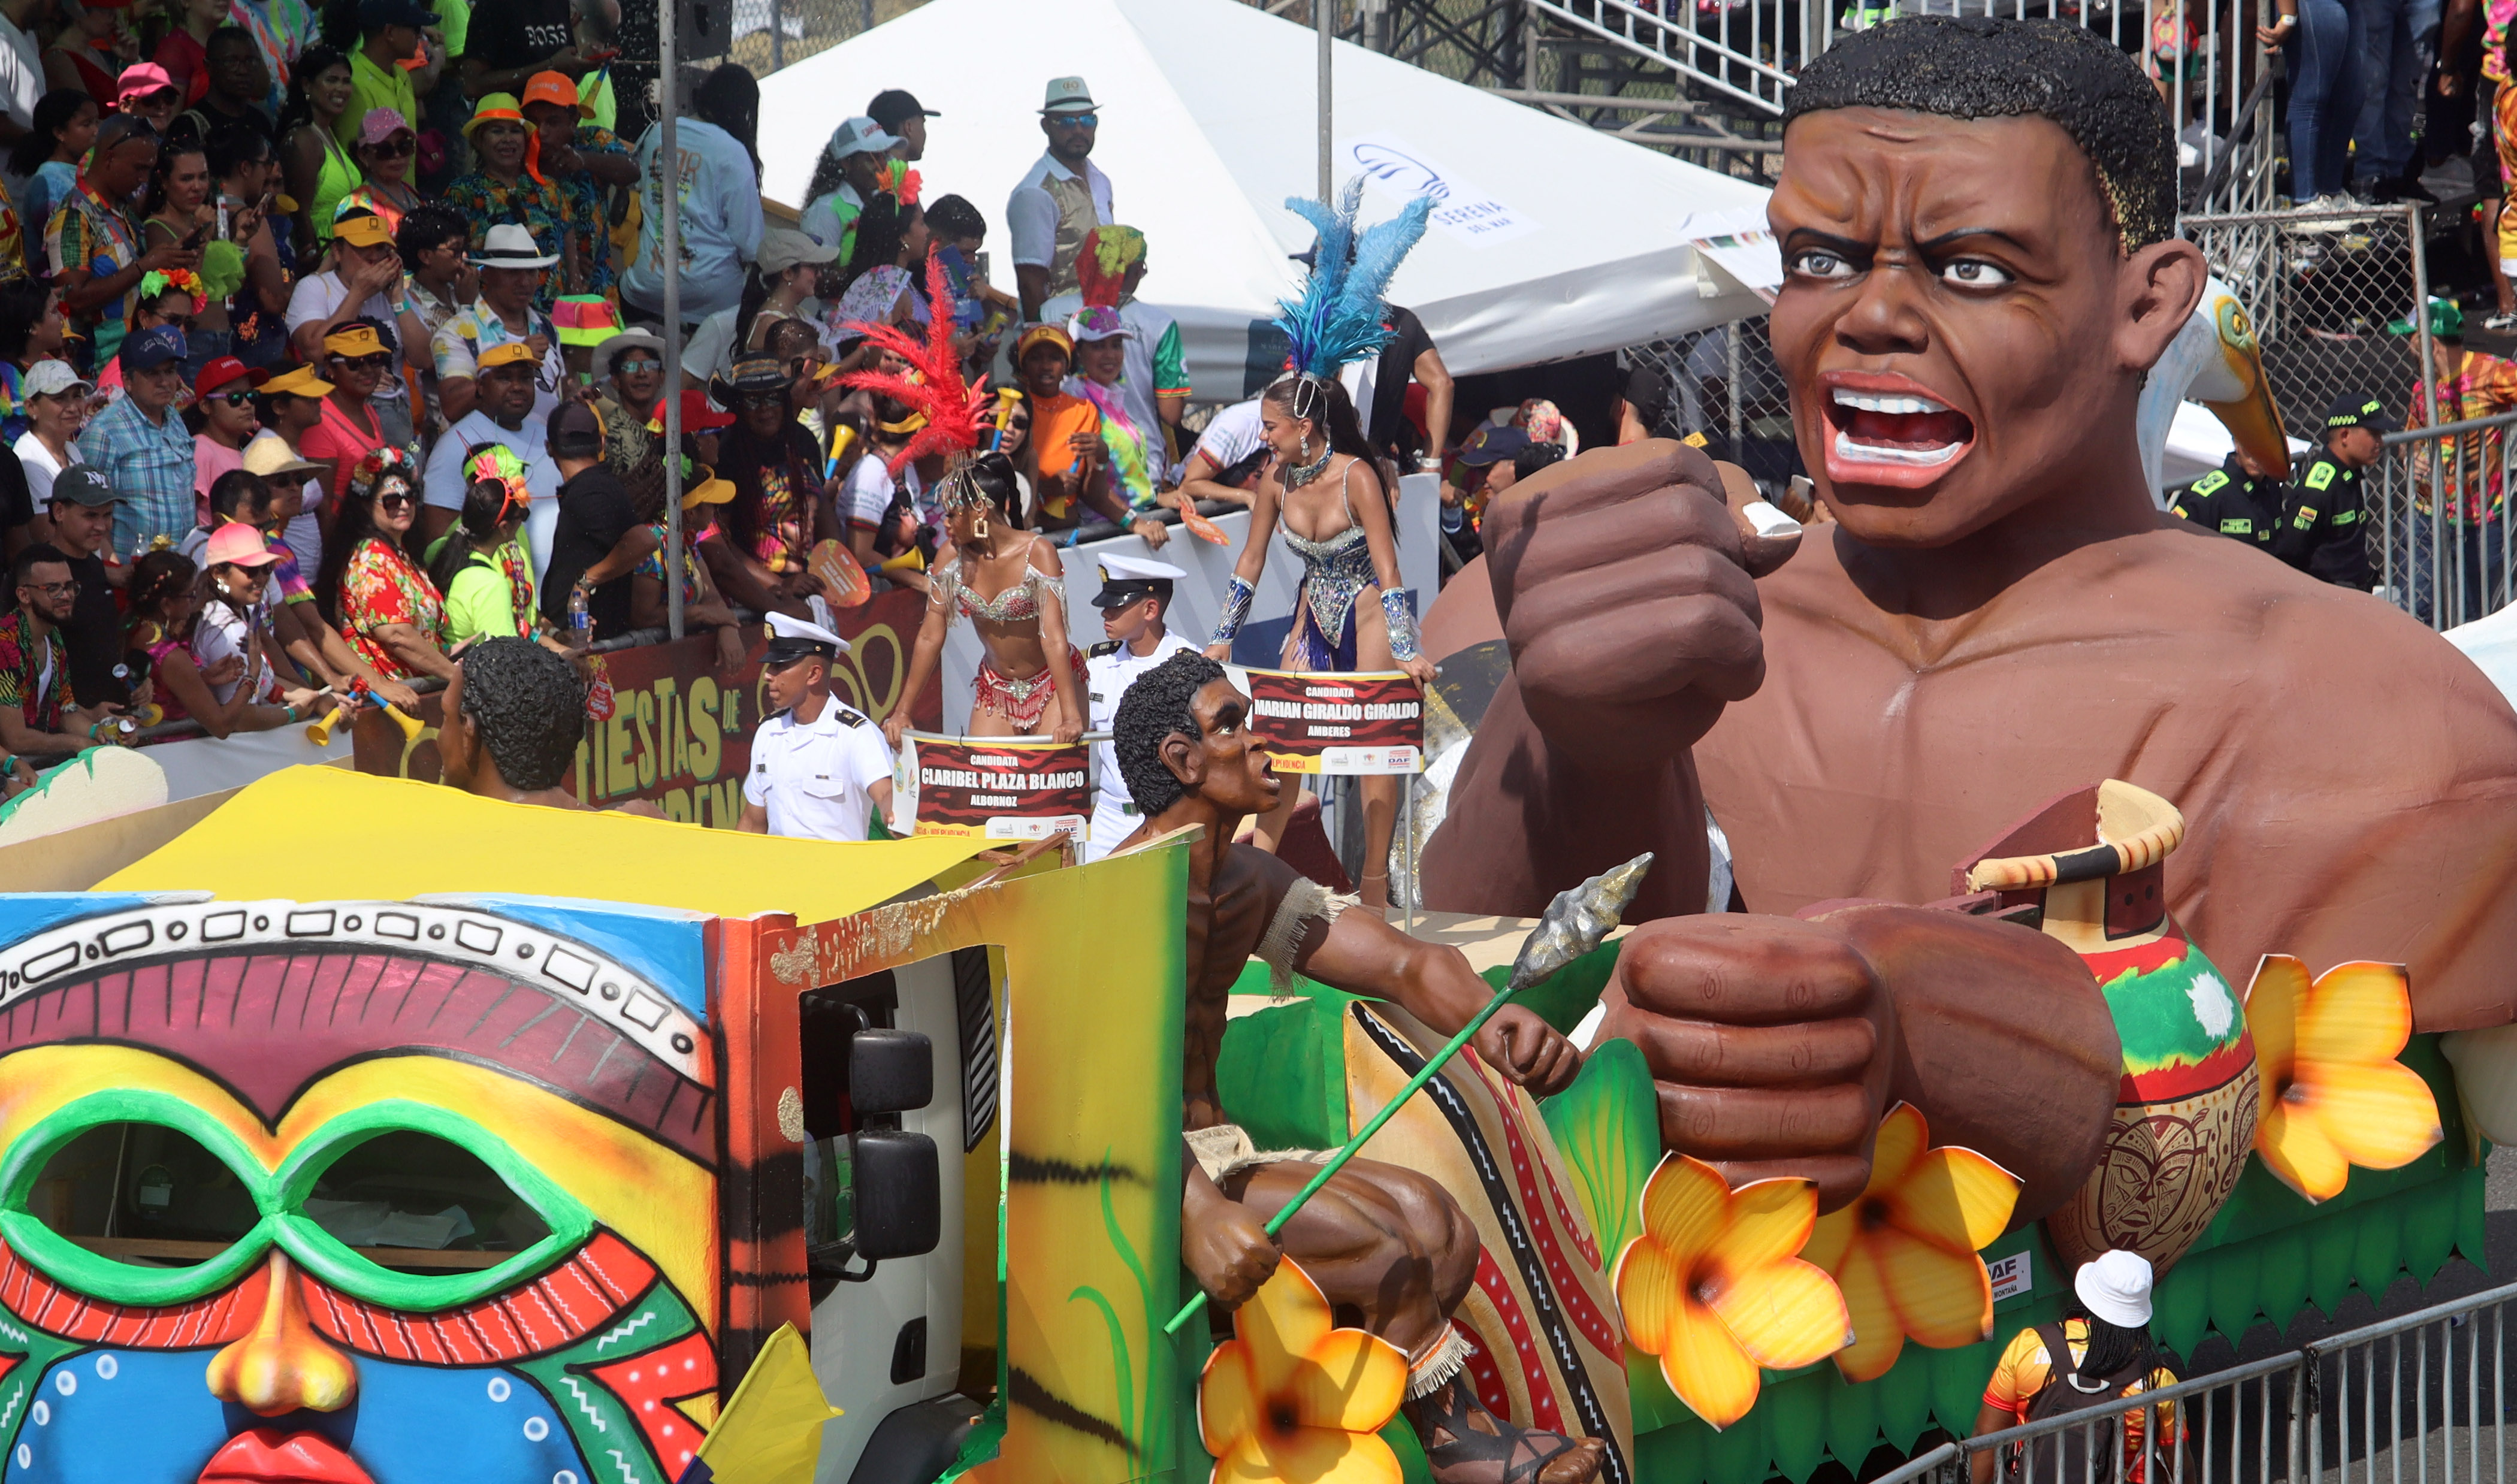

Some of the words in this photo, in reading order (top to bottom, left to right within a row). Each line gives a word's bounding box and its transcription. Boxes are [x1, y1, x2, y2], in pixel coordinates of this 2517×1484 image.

[524, 24, 567, 46] BOSS
[1433, 201, 1509, 225] SERENA
[1305, 686, 1355, 698] CANDIDATA
[723, 689, 742, 733] DE
[1254, 699, 1301, 719] MARIAN
[1303, 703, 1362, 721] GIRALDO
[1364, 702, 1419, 721] GIRALDO
[1307, 725, 1351, 738] AMBERES
[969, 754, 1019, 767] CANDIDATA
[1271, 758, 1306, 770] EPENDENCIA
[921, 767, 980, 789] CLARIBEL
[981, 772, 1027, 790] PLAZA
[1029, 770, 1084, 790] BLANCO
[969, 794, 1018, 807] ALBORNOZ
[1989, 1259, 2017, 1280] AF
[1993, 1284, 2018, 1299] MONTAÑA
